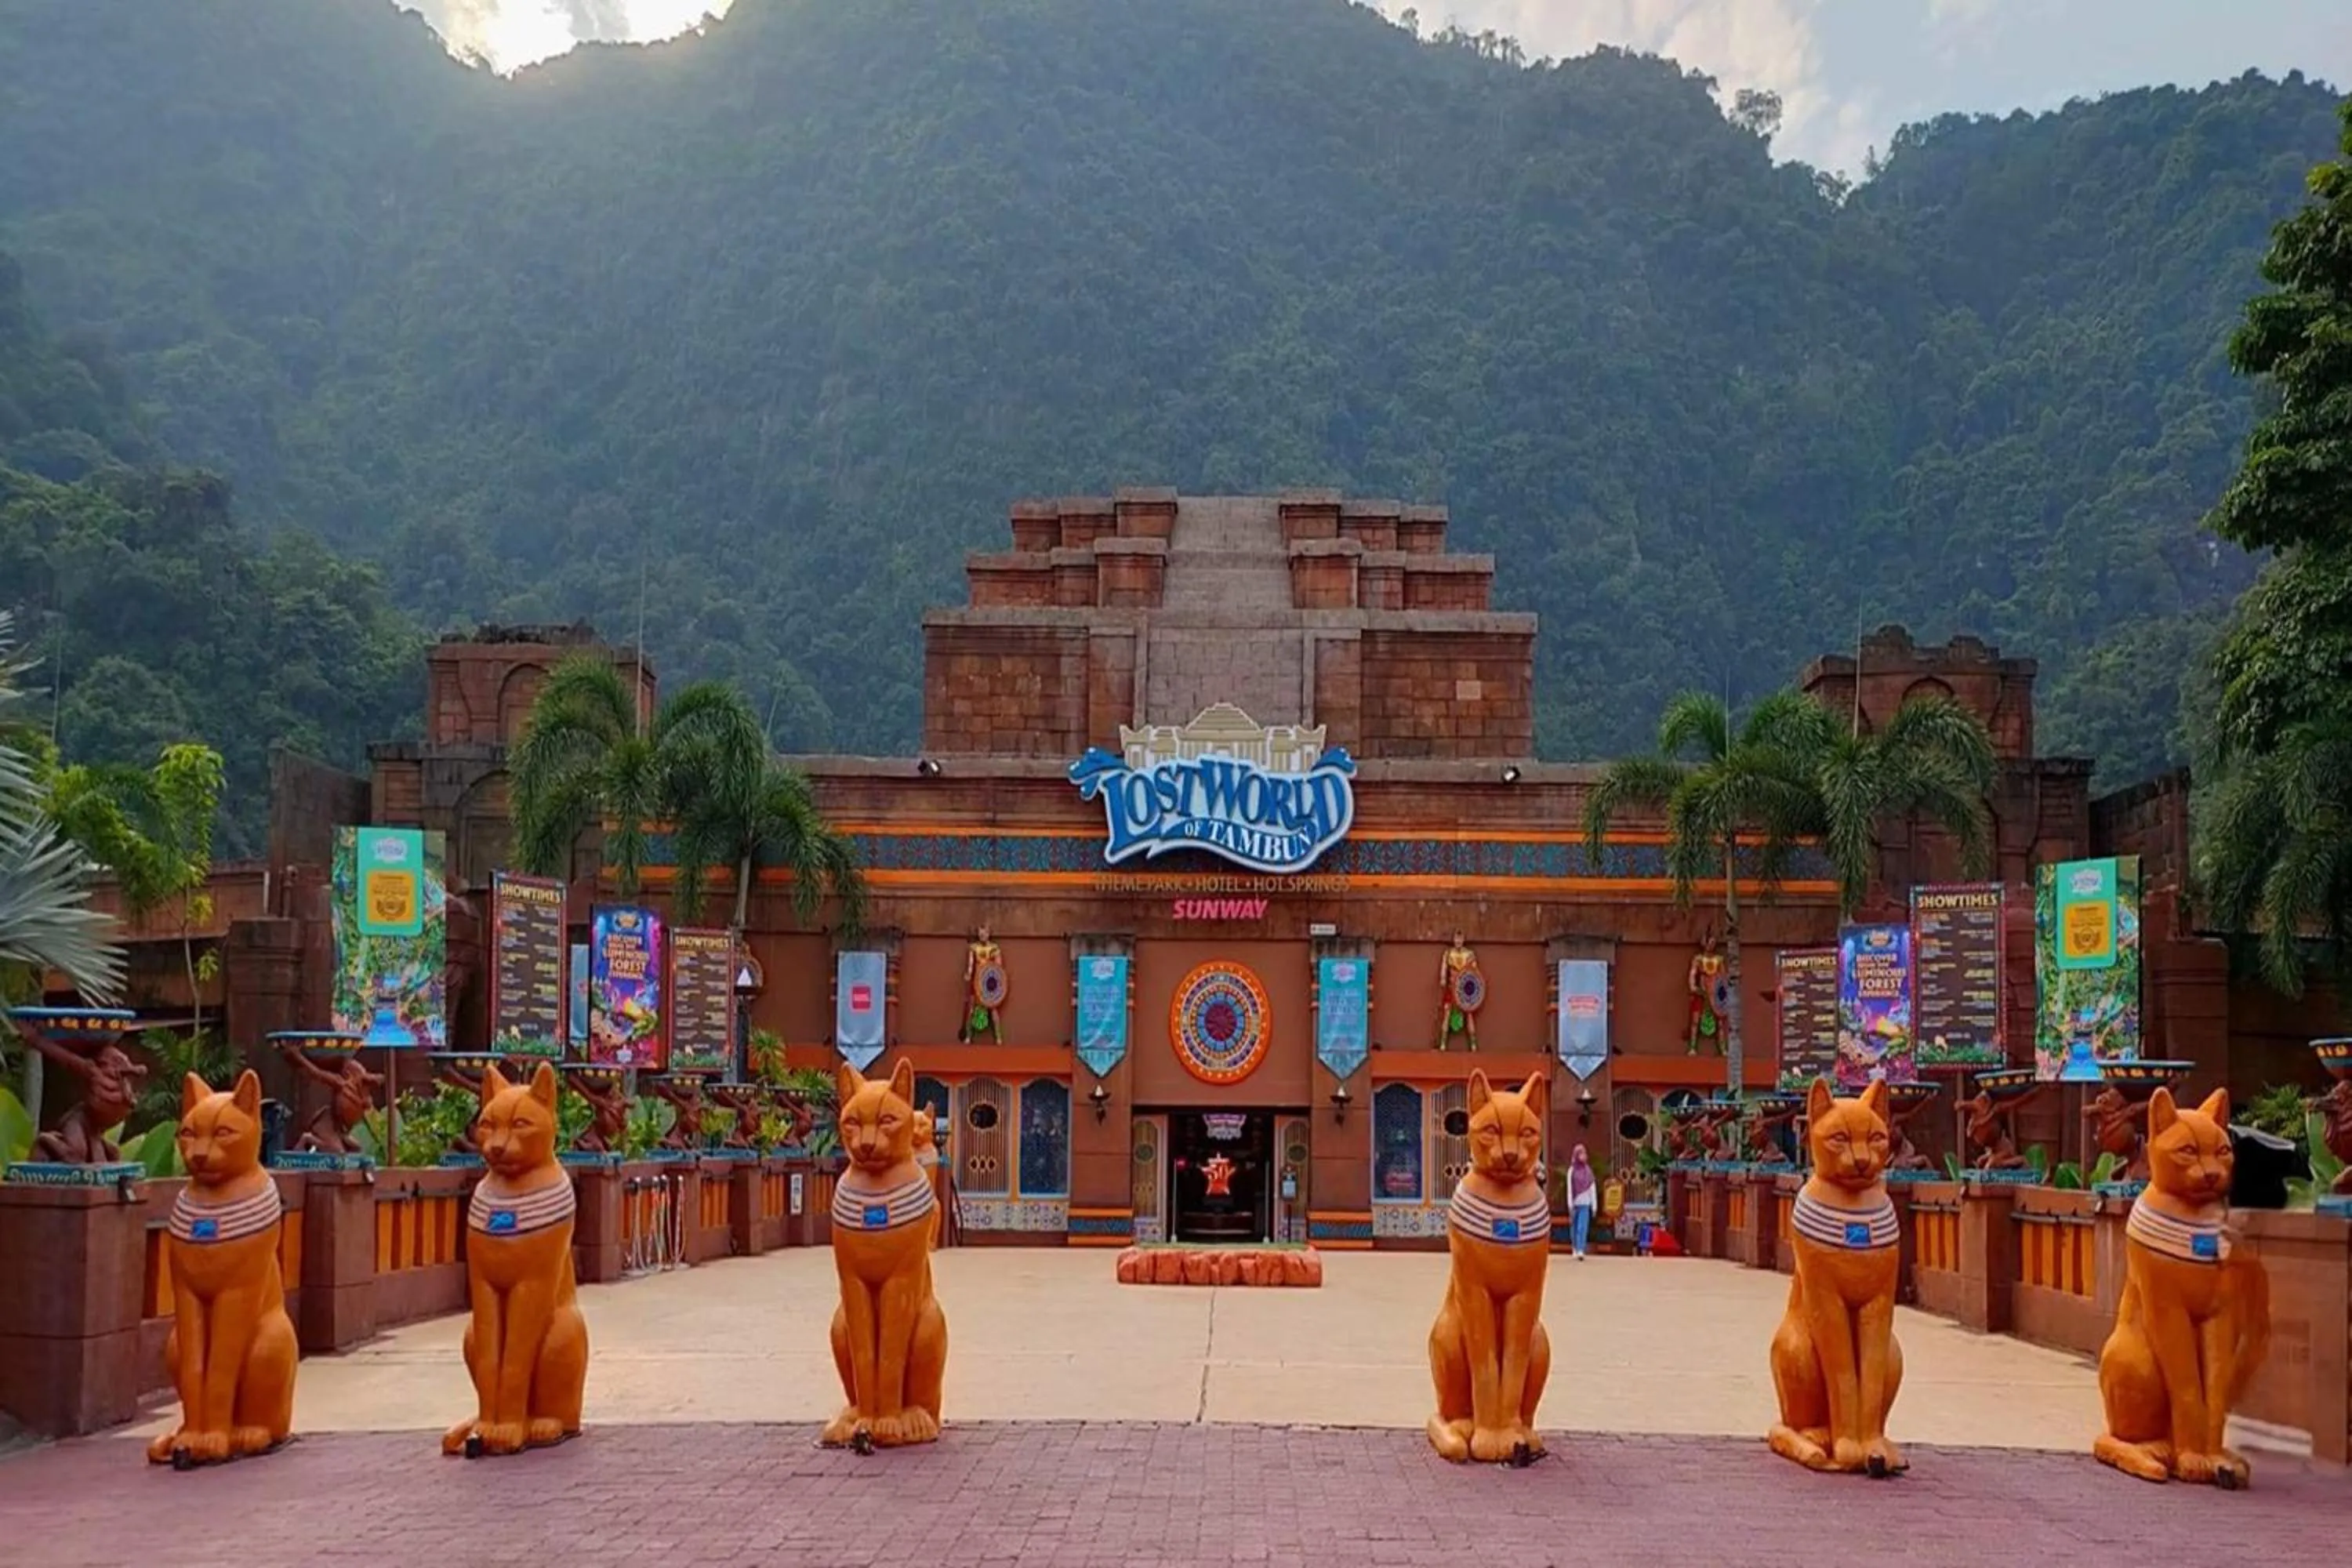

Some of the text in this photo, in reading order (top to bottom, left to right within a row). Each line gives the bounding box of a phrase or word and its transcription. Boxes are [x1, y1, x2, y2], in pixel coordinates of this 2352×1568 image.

[1103, 758, 1347, 855] LOST WORLD
[1185, 819, 1313, 861] OF TAMBUN
[1196, 876, 1242, 891] HOTEL
[1254, 876, 1284, 892] HOT
[1286, 875, 1350, 892] SPRINGS
[500, 883, 561, 905] SHOWTIMES
[1917, 893, 1998, 909] SHOWTIMES
[1173, 899, 1268, 920] SUNWAY
[609, 959, 646, 972] FOREST
[1859, 978, 1903, 990] FOREST
